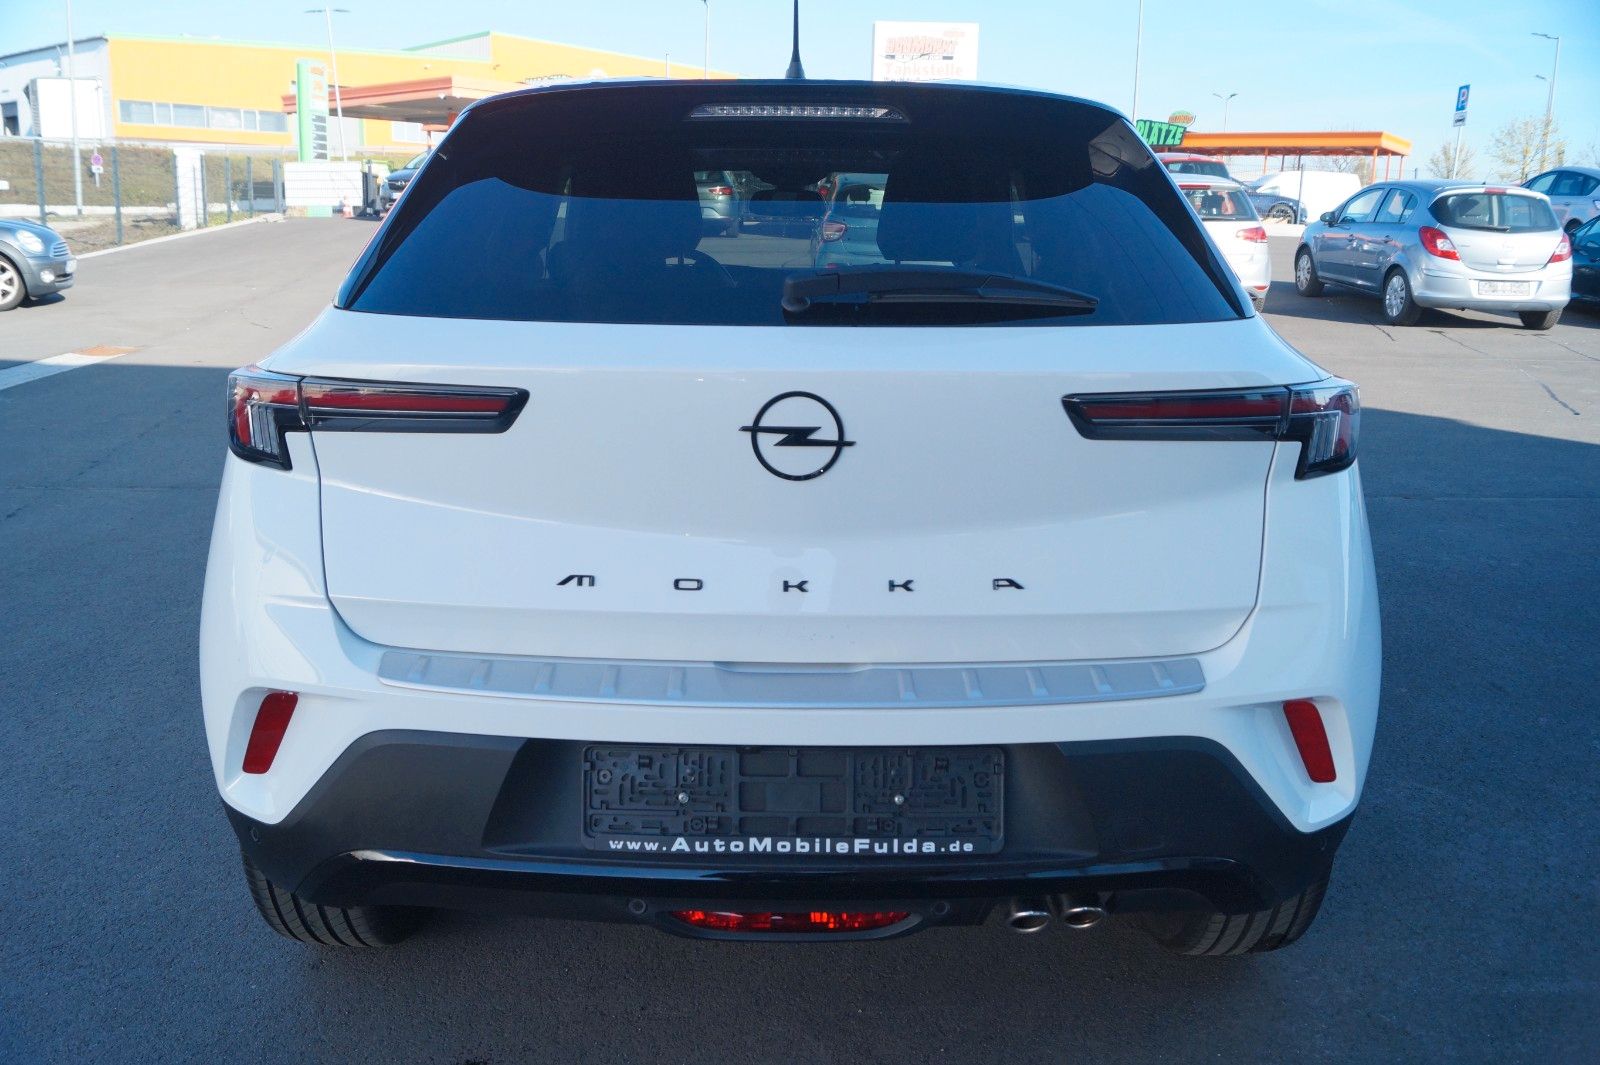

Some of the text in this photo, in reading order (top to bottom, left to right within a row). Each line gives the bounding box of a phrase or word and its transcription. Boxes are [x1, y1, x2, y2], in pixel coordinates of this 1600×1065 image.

[884, 62, 962, 76] Tankstelle
[1457, 89, 1468, 108] P
[608, 837, 974, 854] www.AutoMobileFulda.de
